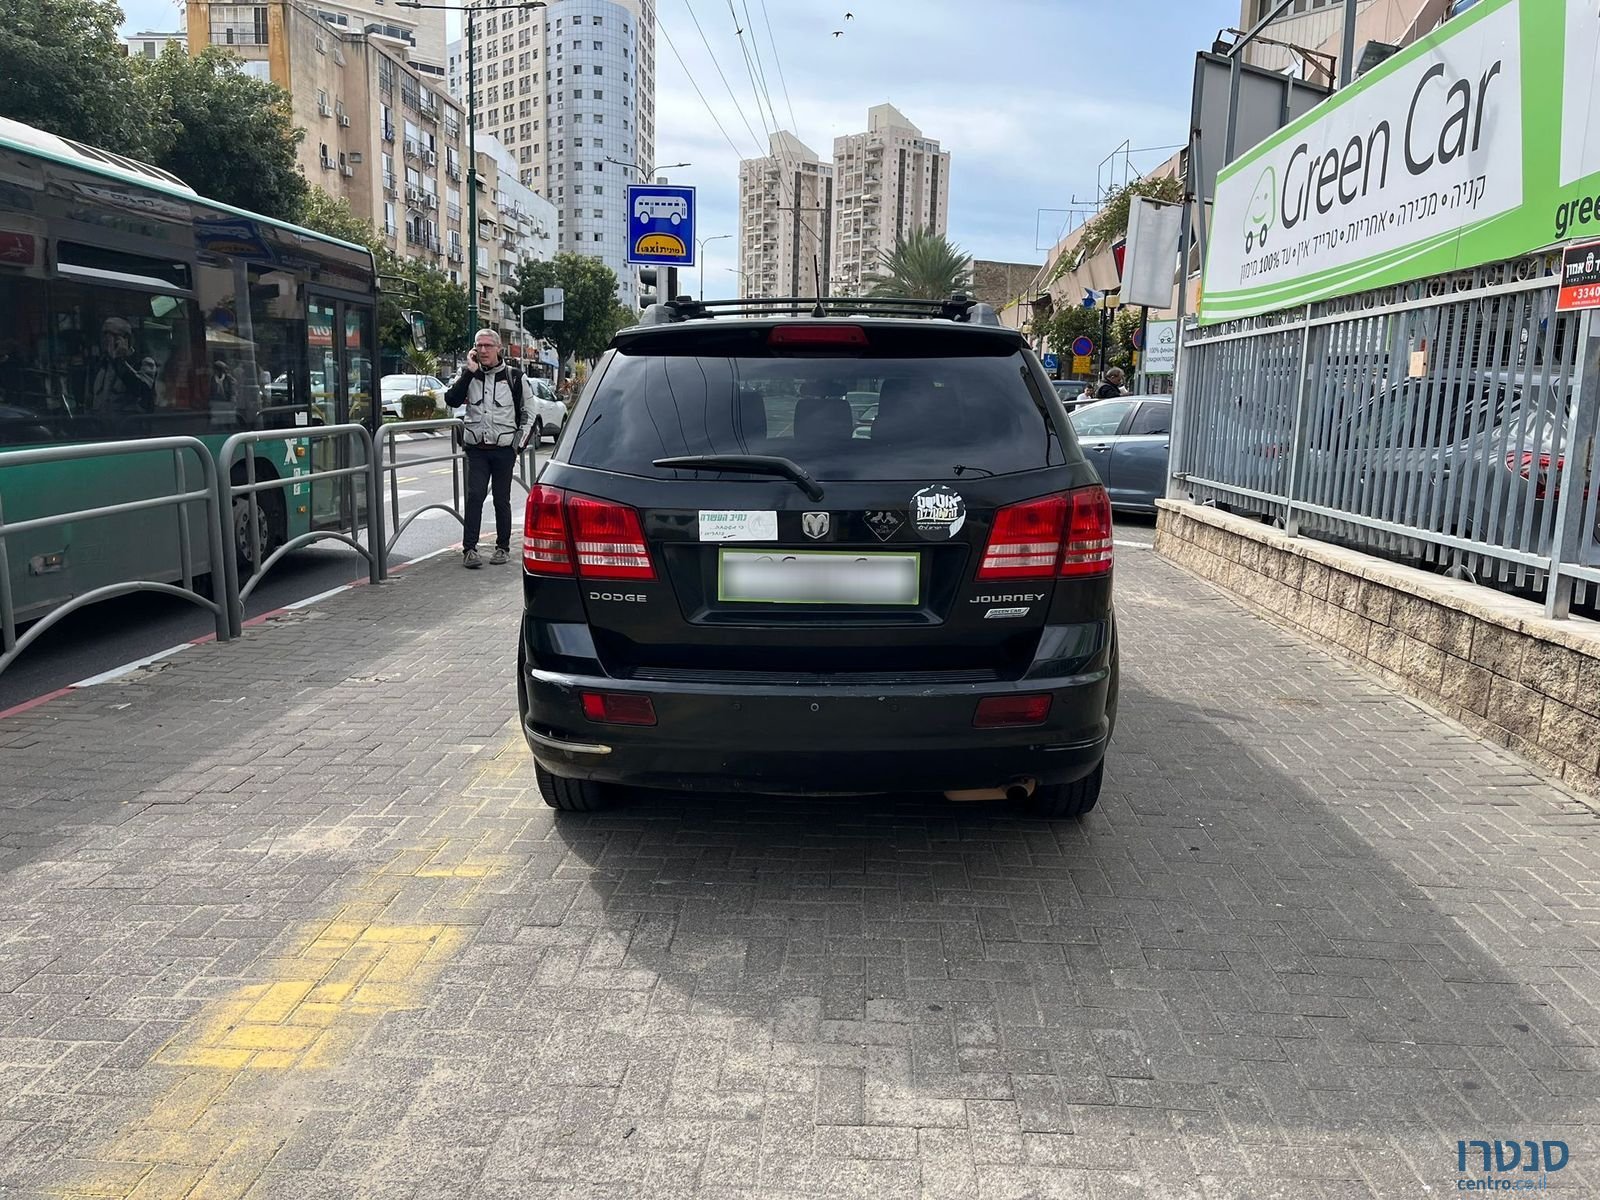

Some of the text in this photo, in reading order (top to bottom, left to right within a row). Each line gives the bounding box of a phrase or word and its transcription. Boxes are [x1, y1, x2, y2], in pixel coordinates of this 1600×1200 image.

[1280, 60, 1502, 230] Green Car
[1450, 175, 1486, 210] קניה
[1397, 192, 1438, 226] מכירה
[1345, 210, 1387, 244] אחריות
[641, 241, 659, 253] taxi
[1296, 239, 1311, 266] אין
[1313, 229, 1338, 254] טרייד
[1259, 251, 1280, 274] 100%
[589, 591, 648, 603] DODGE
[969, 593, 1045, 604] JOURNEY
